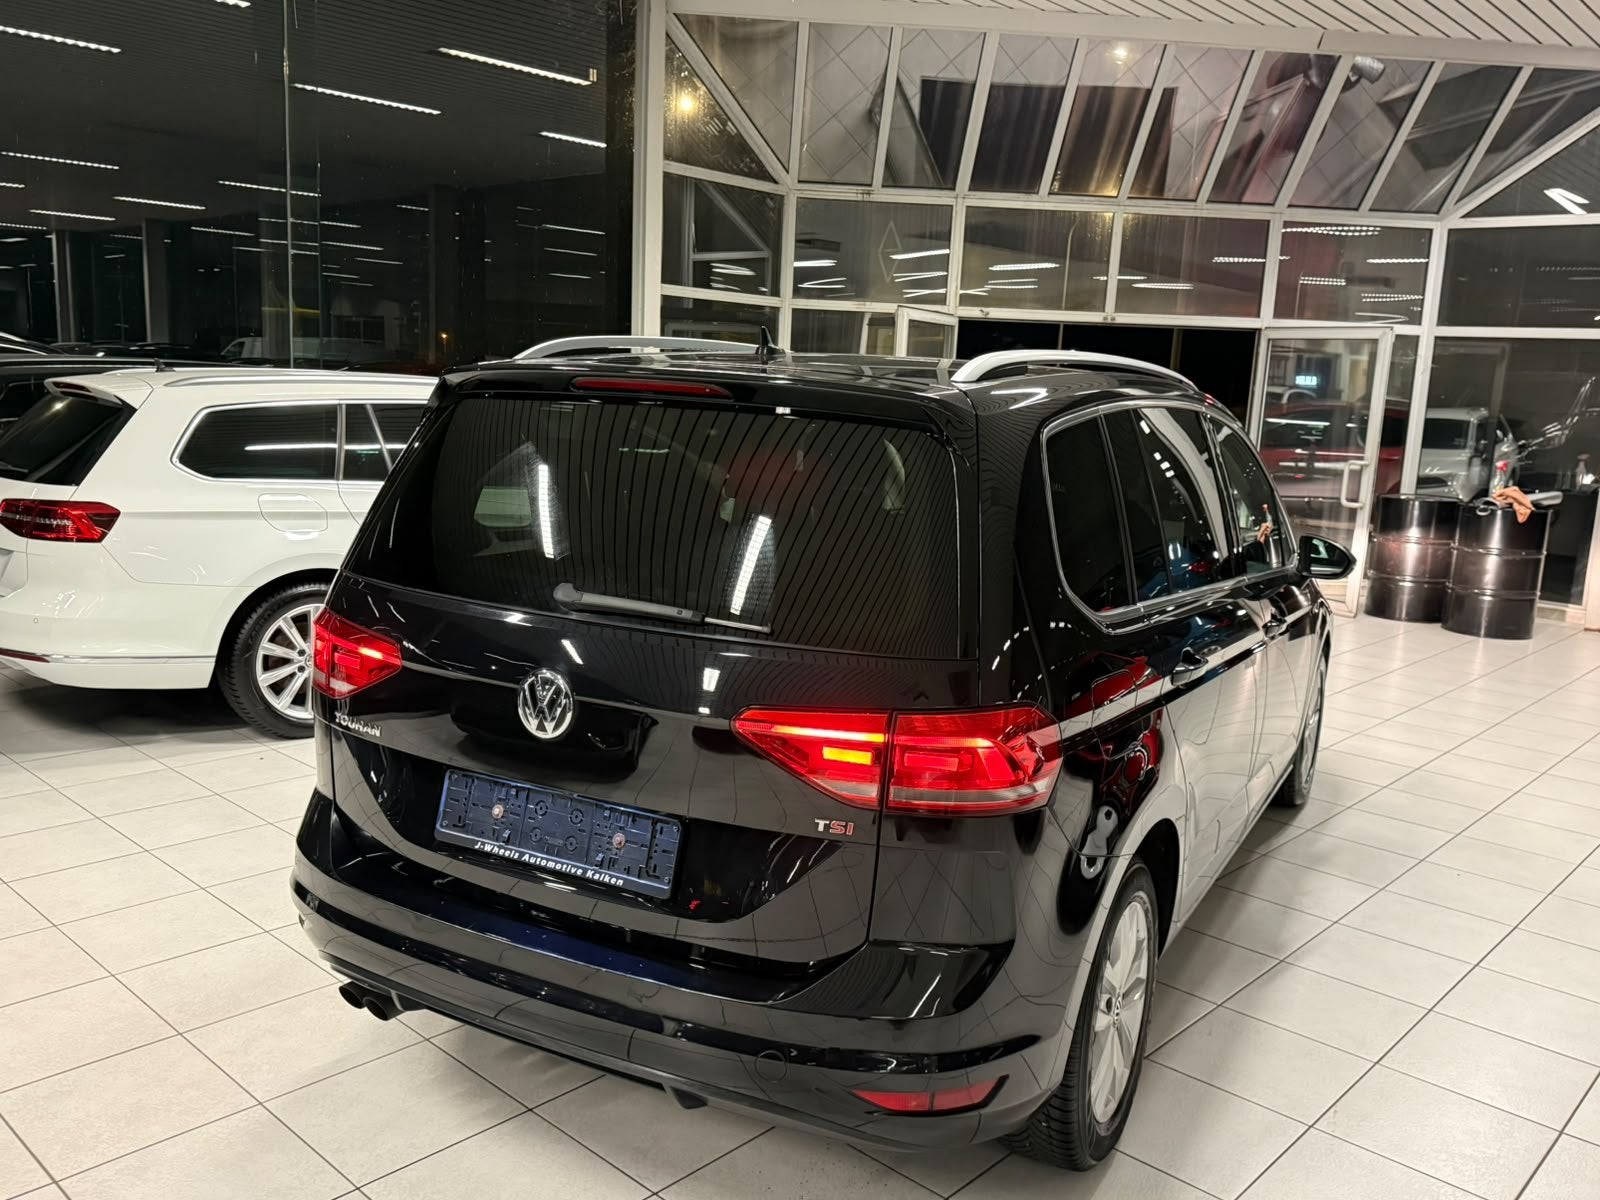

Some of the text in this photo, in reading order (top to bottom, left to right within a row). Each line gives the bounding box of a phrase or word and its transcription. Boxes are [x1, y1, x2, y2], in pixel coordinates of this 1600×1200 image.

[518, 669, 573, 739] VW
[814, 818, 854, 836] TSI
[474, 841, 624, 887] J-Wheels Automotive Kalken
